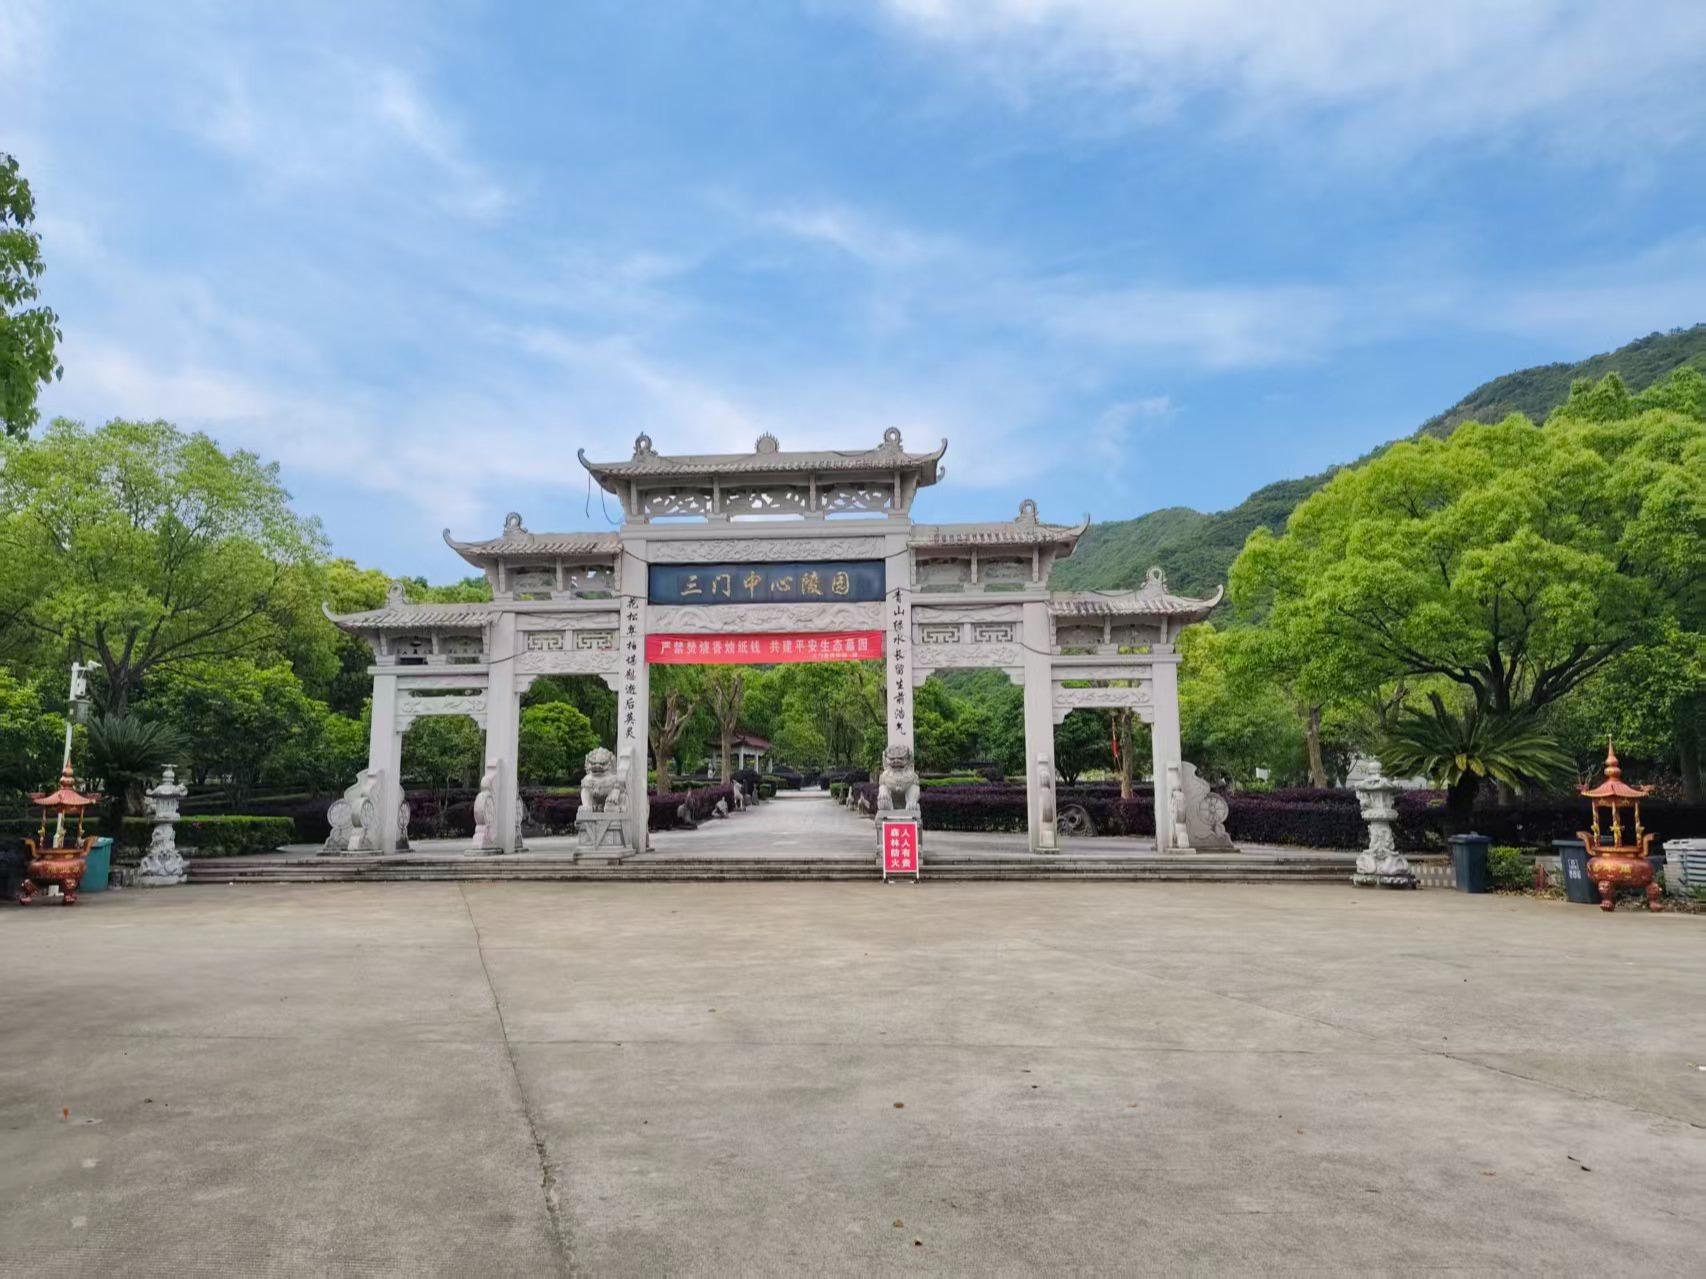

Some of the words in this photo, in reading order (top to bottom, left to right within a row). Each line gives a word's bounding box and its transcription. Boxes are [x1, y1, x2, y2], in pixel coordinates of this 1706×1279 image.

[681, 571, 850, 599] 三门中心陵园
[769, 638, 867, 653] 共建平安生态墓园
[890, 829, 900, 868] 森林防火
[902, 829, 910, 868] 人人有责
